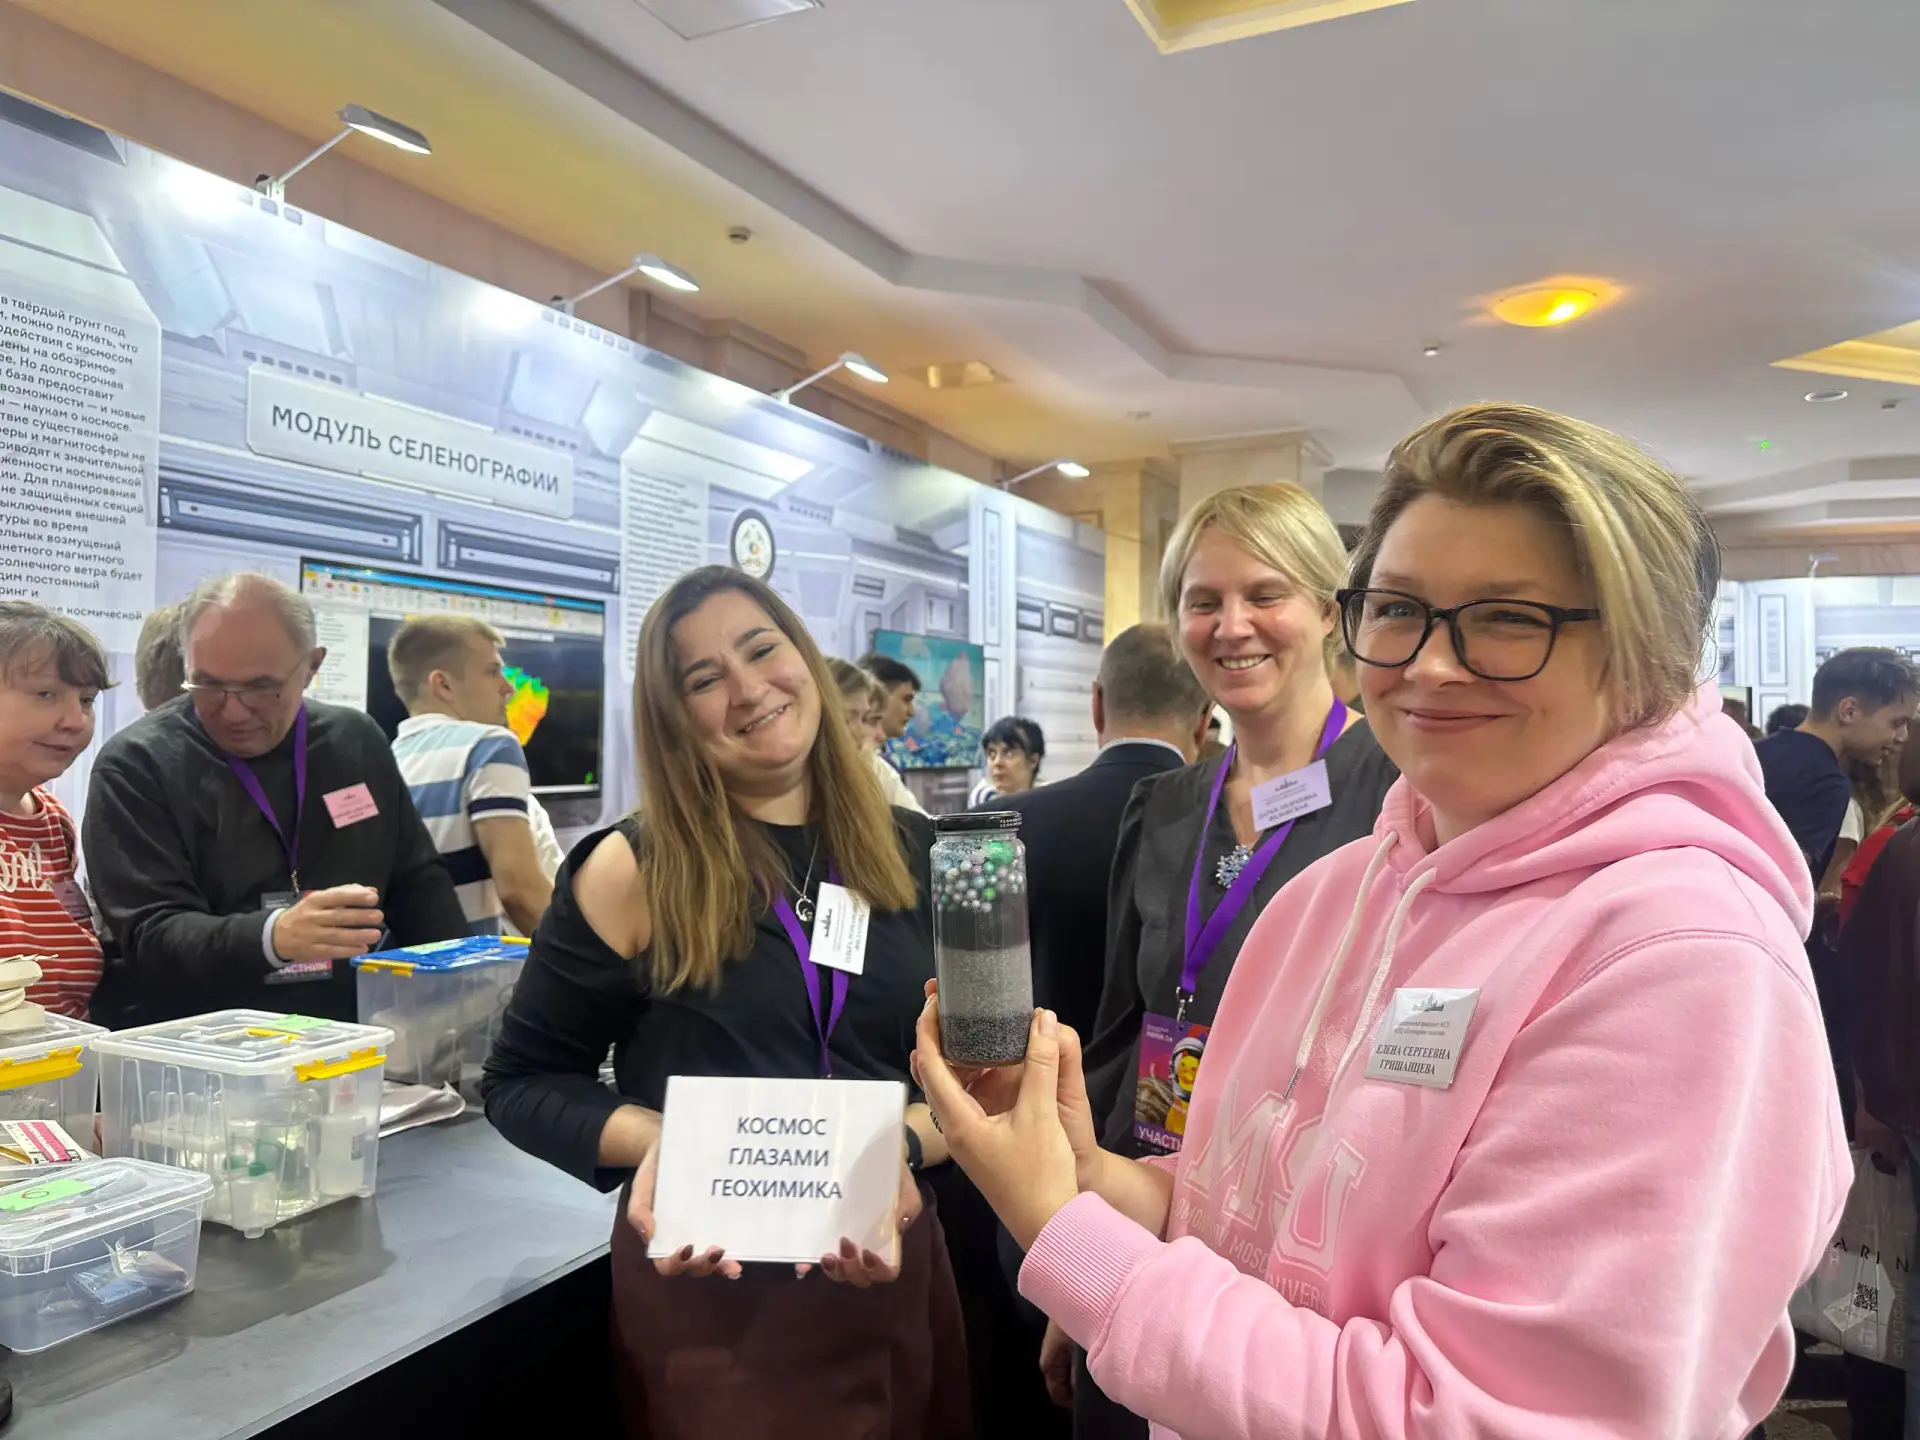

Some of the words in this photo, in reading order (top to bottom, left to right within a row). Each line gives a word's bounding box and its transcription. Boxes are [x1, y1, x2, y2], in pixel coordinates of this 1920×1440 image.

[1, 296, 8, 304] в
[12, 299, 65, 320] твёрдый
[69, 315, 101, 330] грунт
[104, 324, 126, 338] под
[12, 313, 54, 331] можно
[57, 326, 116, 348] подумать,
[119, 343, 138, 354] что
[33, 347, 48, 358] на
[51, 352, 116, 375] обозримое
[66, 342, 73, 350] с
[76, 344, 133, 365] космосом
[20, 356, 37, 369] Но
[40, 364, 124, 390] долгосрочная
[6, 368, 34, 383] база
[38, 377, 115, 401] предоставит
[0, 383, 84, 408] возможности
[100, 405, 108, 413] и
[110, 408, 146, 422] новые
[23, 403, 68, 418] наукам
[71, 412, 78, 421] о
[81, 415, 132, 432] космосе.
[32, 419, 119, 442] существенной
[0, 427, 28, 438] еры
[31, 433, 39, 442] и
[42, 435, 129, 458] магнитосферы
[132, 452, 145, 461] на
[272, 404, 381, 450] МОДУЛЬ
[388, 435, 559, 494] СЕЛЕНОГРАФИИ
[53, 451, 61, 459] к
[64, 453, 144, 474] значительной
[24, 472, 49, 485] Для
[52, 479, 136, 499] планирования
[66, 467, 141, 488] космической
[1, 485, 16, 494] не
[20, 488, 100, 508] защищённых
[103, 501, 144, 515] секций
[33, 518, 48, 528] во
[51, 521, 88, 533] время
[75, 511, 126, 525] внешней
[46, 534, 121, 551] возмущений
[0, 544, 53, 556] нетного
[56, 549, 124, 565] магнитного
[26, 574, 100, 589] постоянный
[74, 566, 107, 577] ветра
[110, 568, 143, 581] будет
[31, 589, 39, 598] и
[66, 607, 143, 620] космической
[1376, 1044, 1402, 1056] ЕЛЕНА
[1402, 1045, 1451, 1060] СЕРГЕЕВНА
[1379, 1059, 1436, 1075] ГРИШАНЦЕВА
[737, 1116, 827, 1136] КОСМОС
[728, 1148, 830, 1167] ГЛАЗАМИ
[711, 1179, 843, 1199] ГЕОХИМИКА
